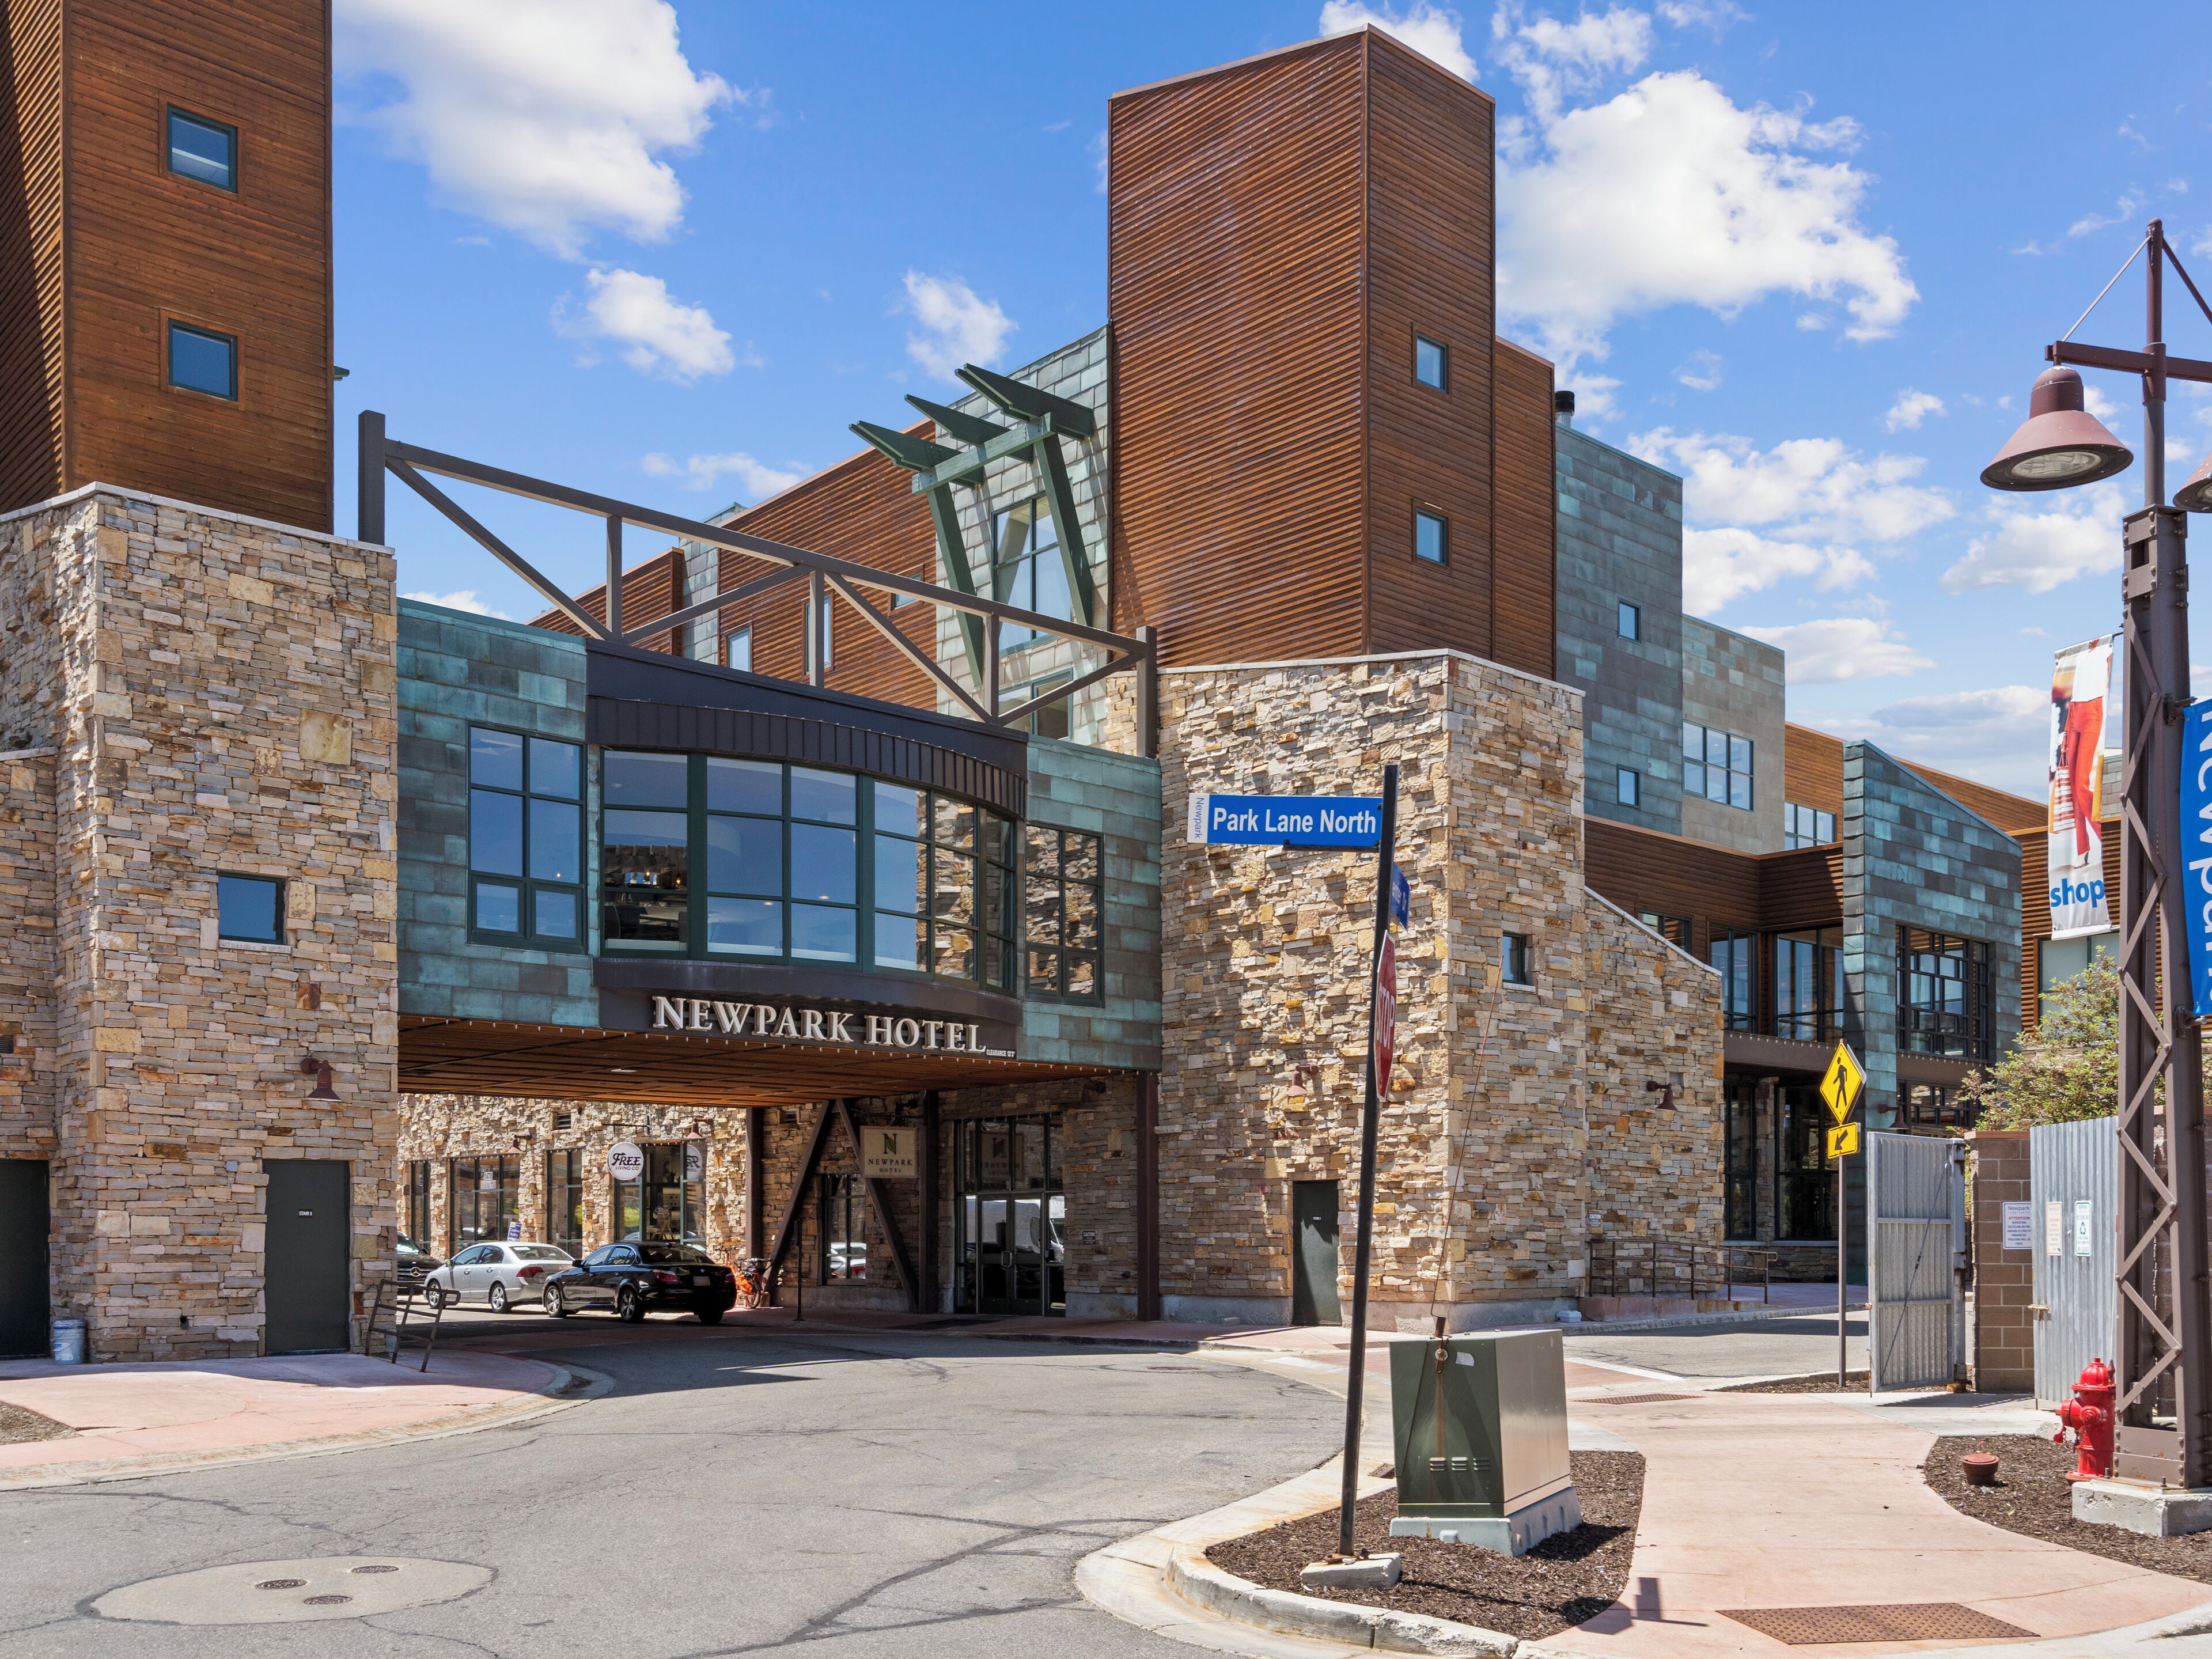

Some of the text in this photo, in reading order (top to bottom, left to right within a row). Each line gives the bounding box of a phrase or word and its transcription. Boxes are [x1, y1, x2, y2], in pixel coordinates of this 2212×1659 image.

[1194, 797, 1205, 839] Newpark
[1213, 807, 1376, 834] Park Lane North
[2050, 878, 2105, 908] shop
[652, 995, 986, 1053] NEWPARK HOTEL
[1376, 982, 1395, 1050] STOP
[986, 1049, 1006, 1057] CLEARANCE
[611, 1152, 641, 1166] FREE
